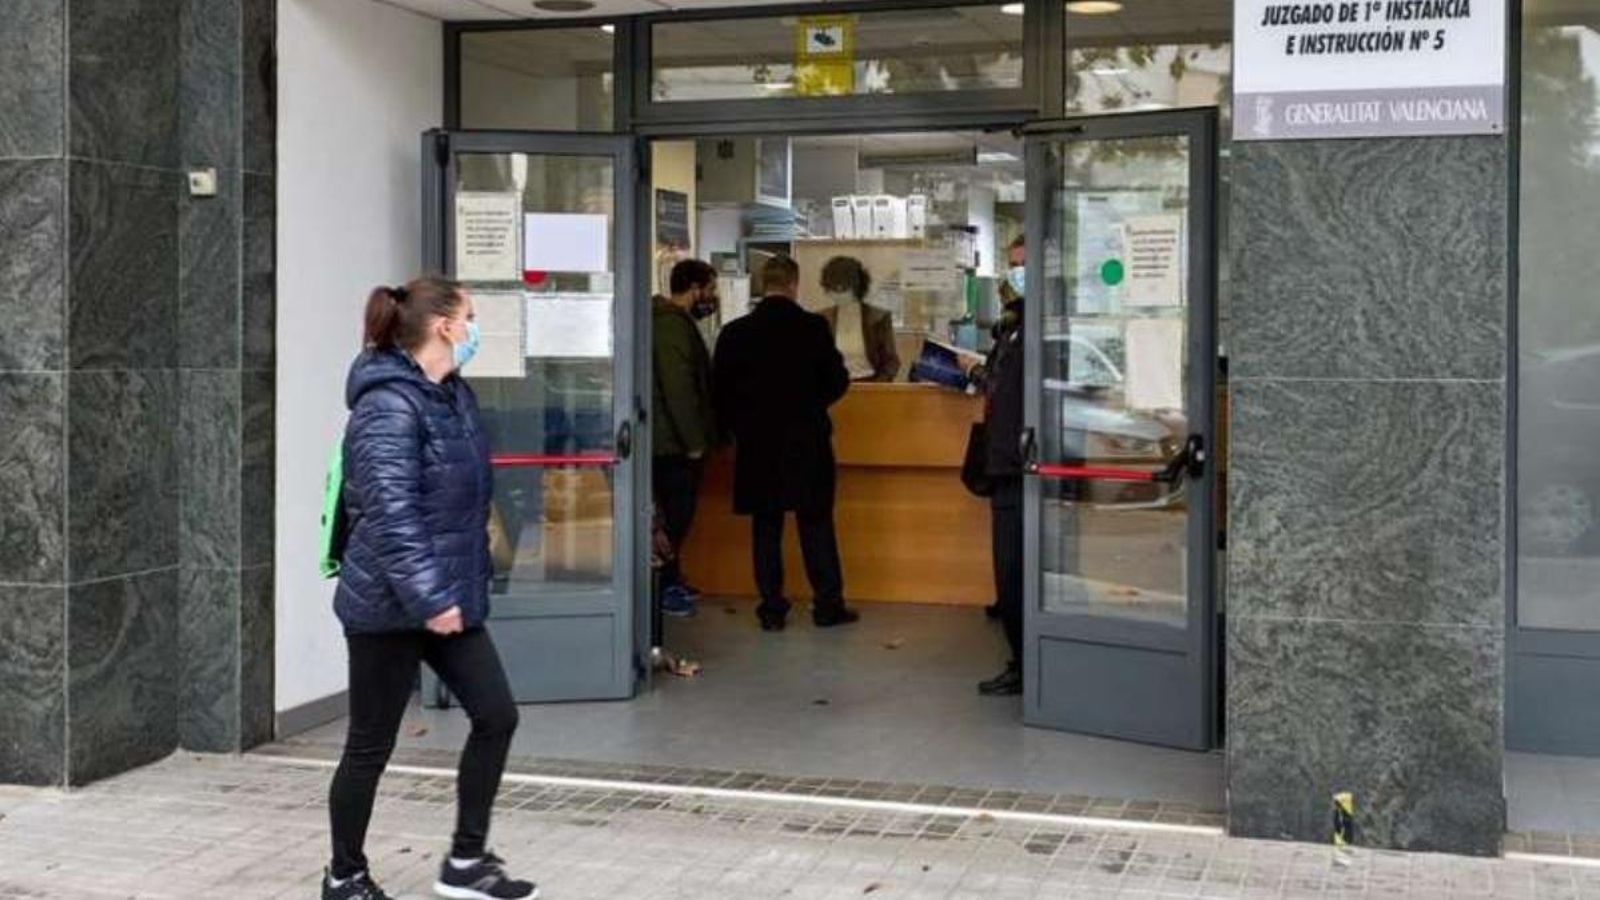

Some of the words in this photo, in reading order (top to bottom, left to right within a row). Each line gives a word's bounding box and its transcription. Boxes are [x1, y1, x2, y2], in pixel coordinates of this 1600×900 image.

[1262, 2, 1334, 26] JUZGADO
[1338, 2, 1358, 23] DE
[1386, 0, 1470, 20] INSTANCIA
[1285, 35, 1296, 55] E
[1299, 27, 1406, 55] INSTRUCCIÓN
[1433, 29, 1446, 50] 5
[1285, 102, 1382, 124] GENERALITAT
[1390, 98, 1487, 121] VALENCIANA
